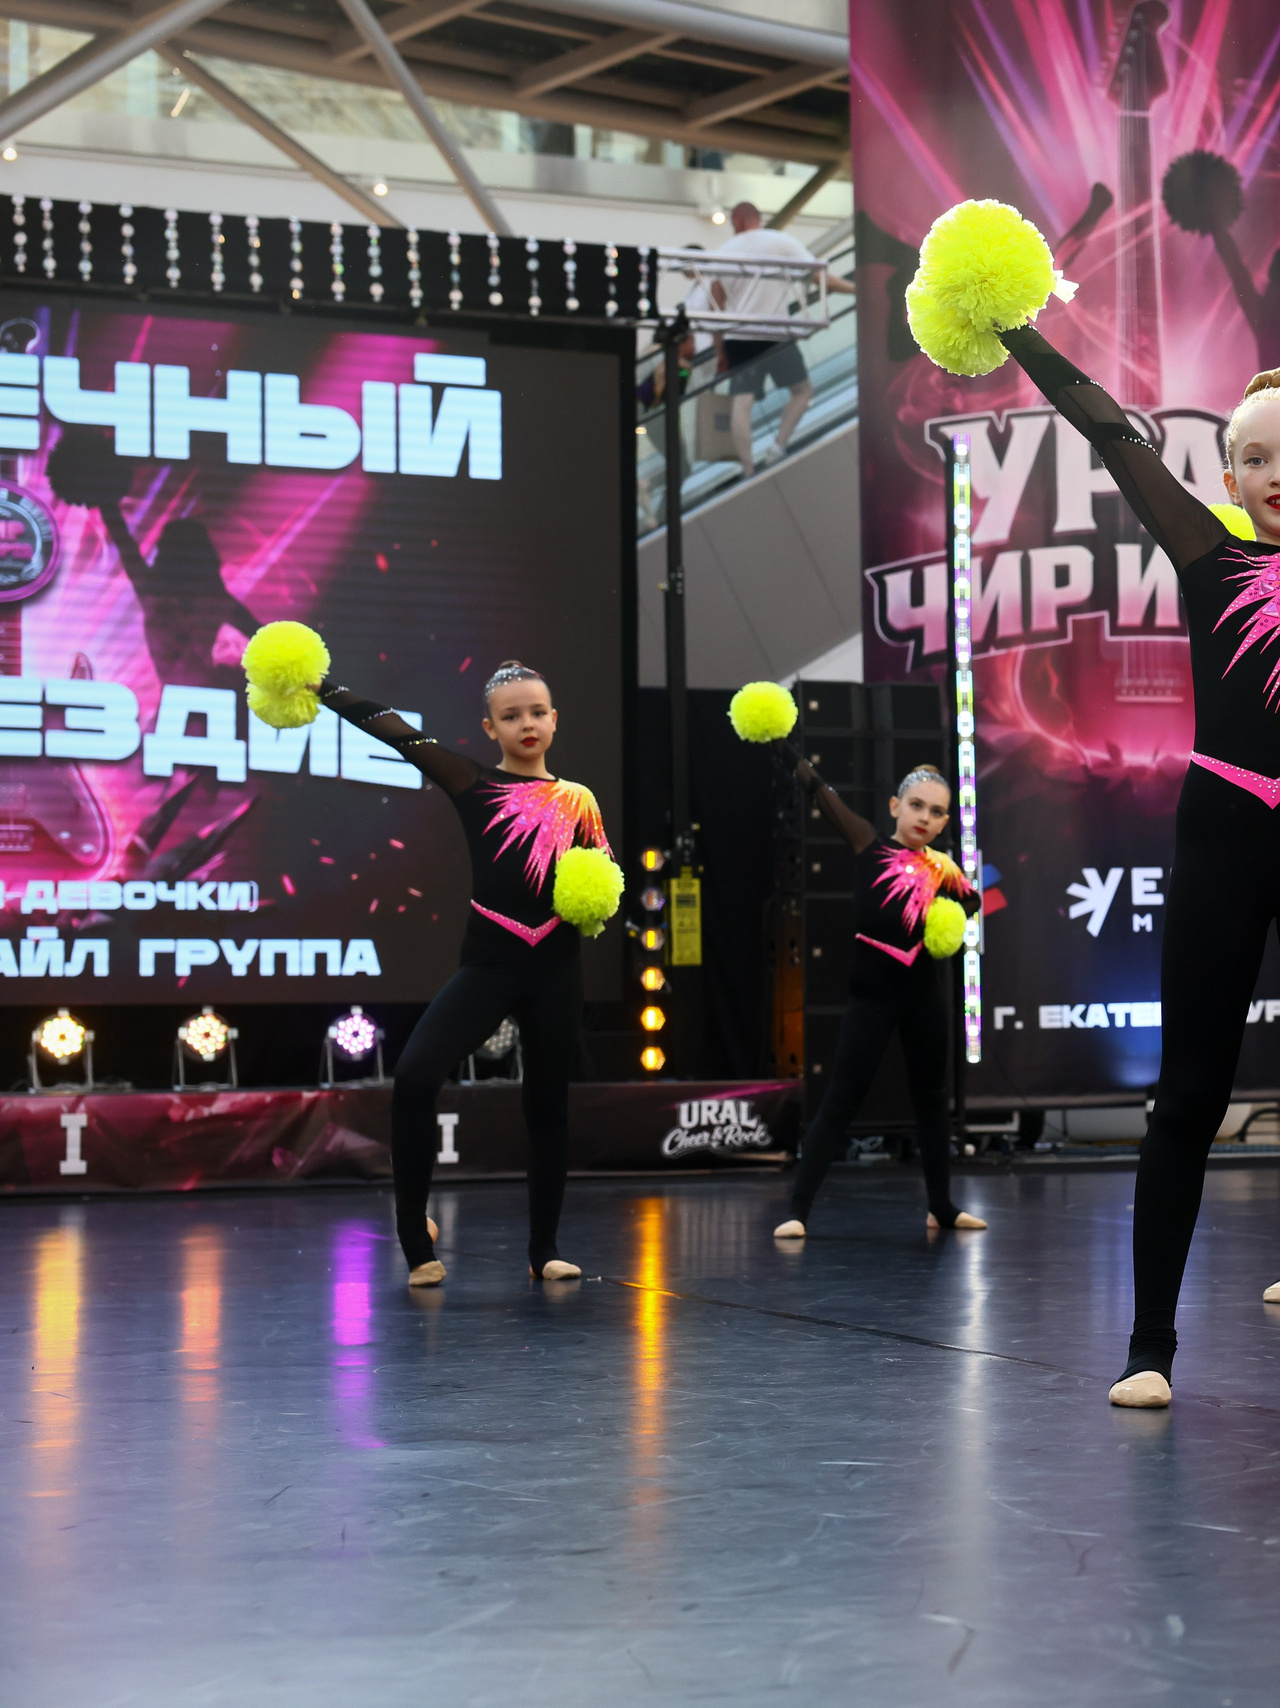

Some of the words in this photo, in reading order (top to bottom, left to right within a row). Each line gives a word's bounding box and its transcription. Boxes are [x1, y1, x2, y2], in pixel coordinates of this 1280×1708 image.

[139, 938, 382, 977] ГРУППА
[993, 1006, 1024, 1030] Г.
[680, 1099, 758, 1129] URAL
[662, 1128, 711, 1156] Cheer
[724, 1123, 772, 1147] Rock
